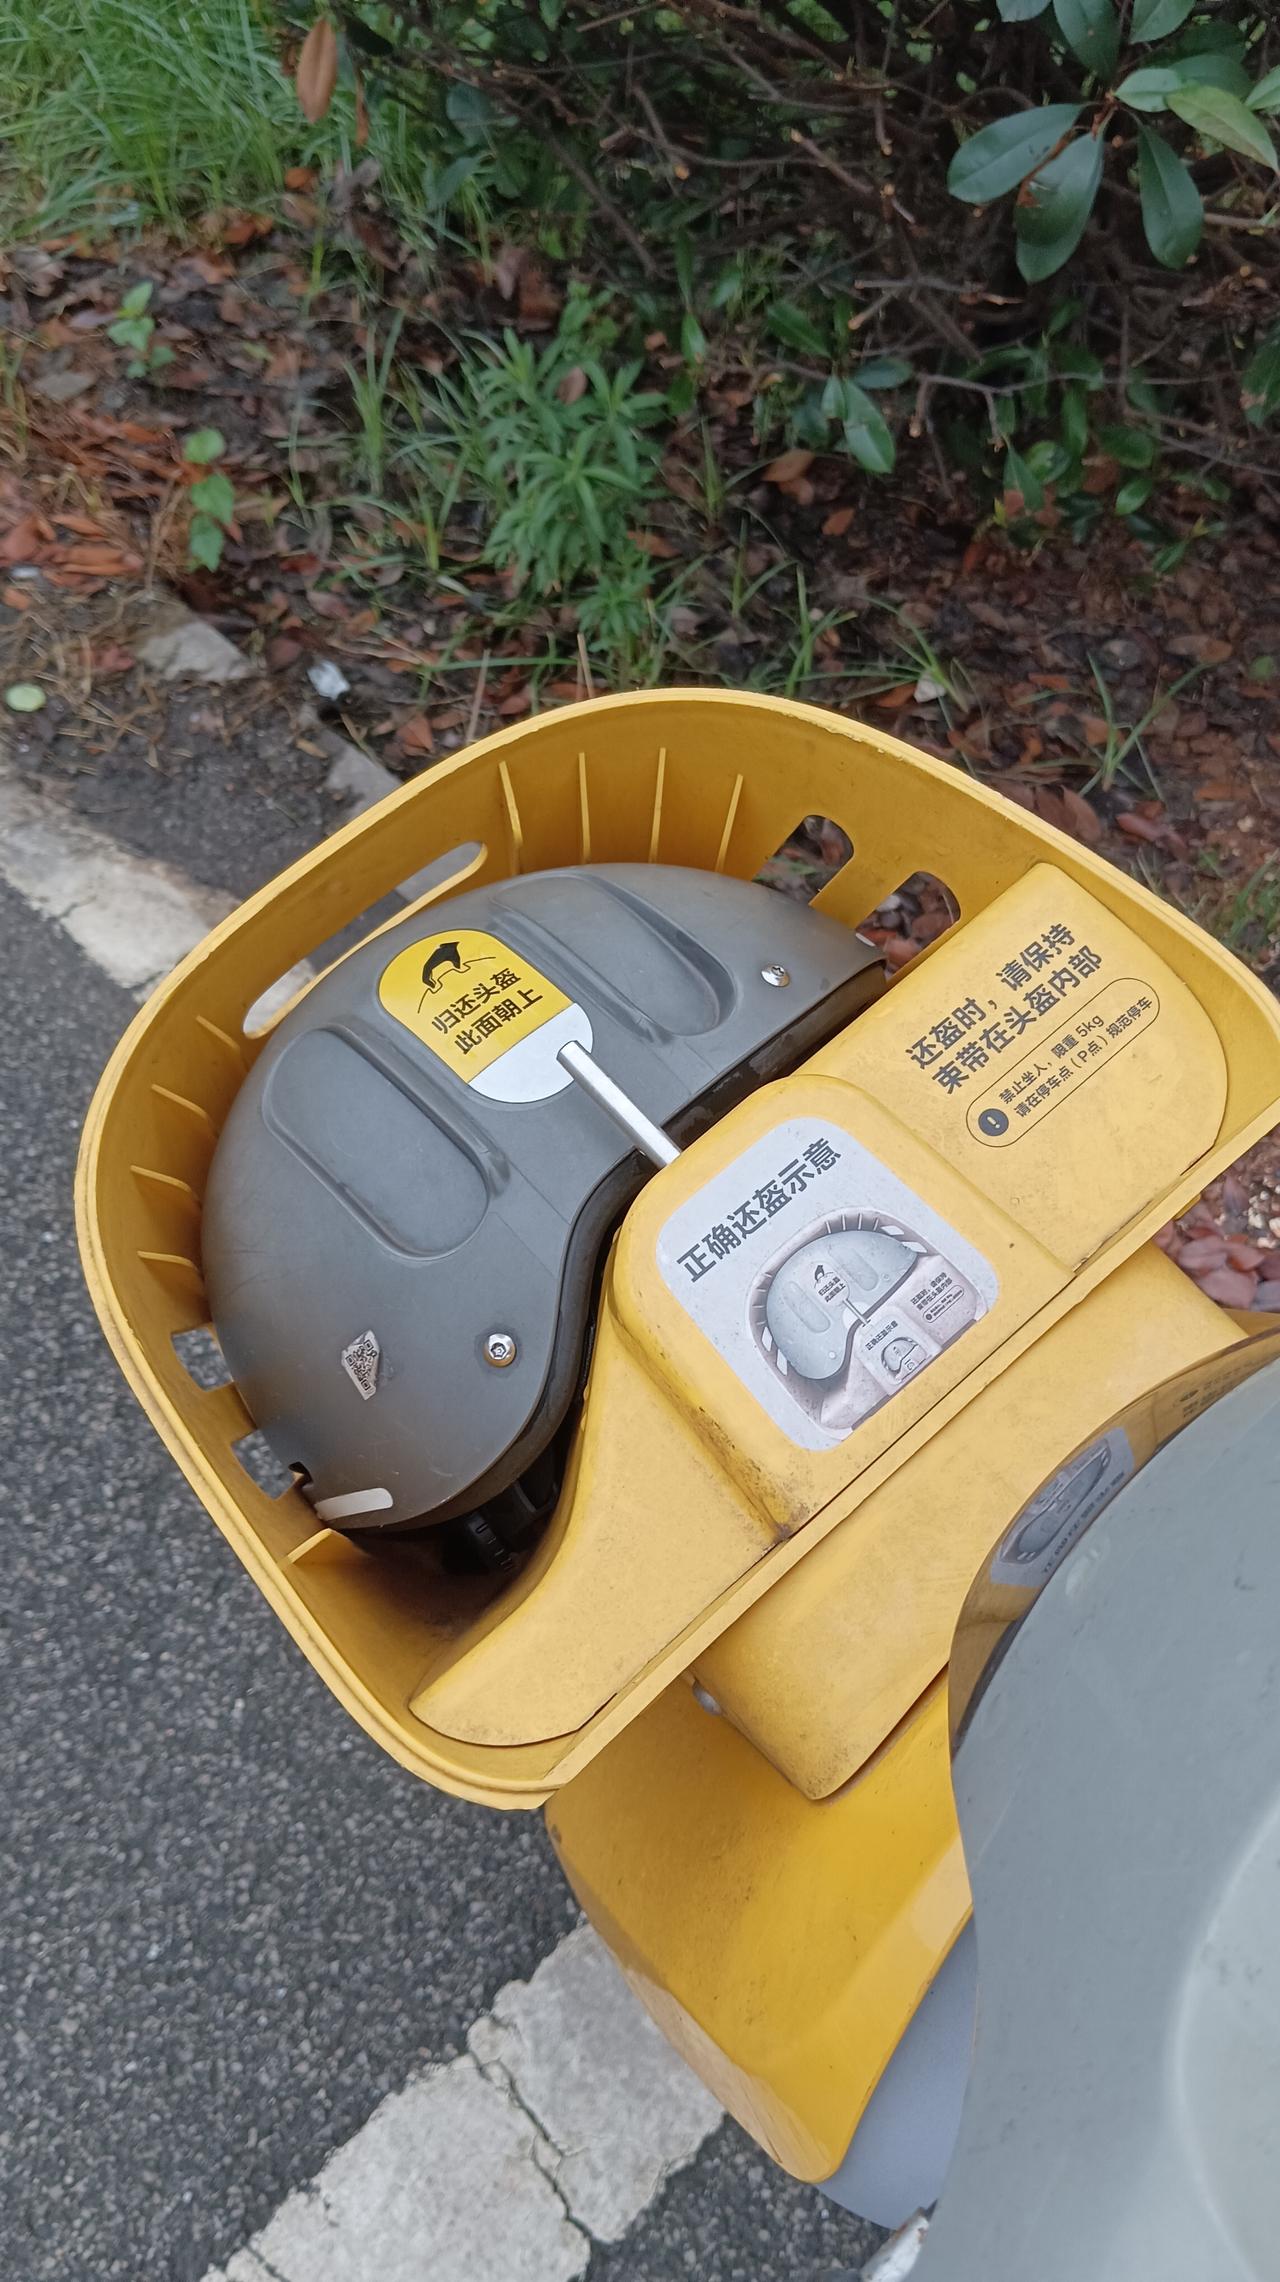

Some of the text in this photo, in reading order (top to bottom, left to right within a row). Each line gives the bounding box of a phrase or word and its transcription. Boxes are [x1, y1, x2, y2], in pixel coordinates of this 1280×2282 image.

[431, 968, 521, 1034] 归还头盔
[454, 988, 543, 1055] 此面朝上
[932, 945, 1103, 1095] 束带在头盔内部
[1074, 1013, 1105, 1038] 5kg
[676, 1137, 842, 1283] 正确还盔示意
